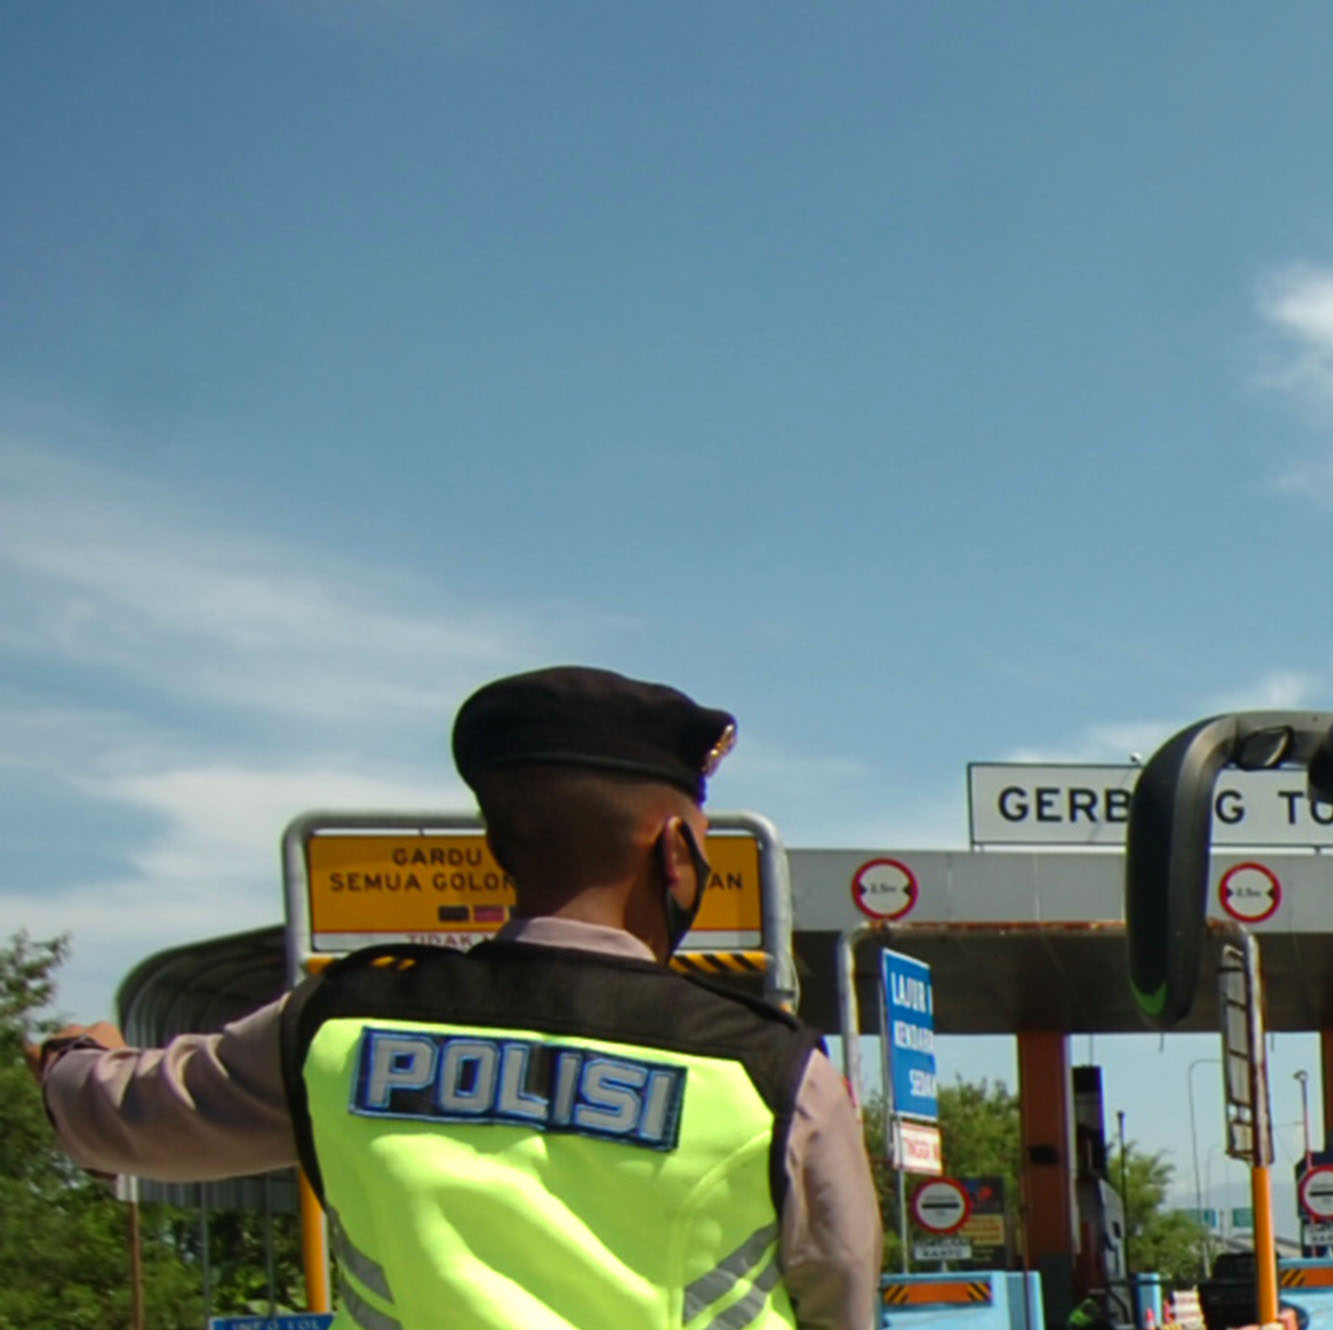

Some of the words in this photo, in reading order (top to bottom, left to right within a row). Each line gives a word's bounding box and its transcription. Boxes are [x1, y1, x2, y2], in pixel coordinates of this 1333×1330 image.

[998, 786, 1246, 825] GERBG
[392, 848, 483, 867] GARDU
[329, 873, 421, 893] SEMUA
[432, 872, 514, 892] GOLON
[364, 1032, 678, 1142] POLISI
